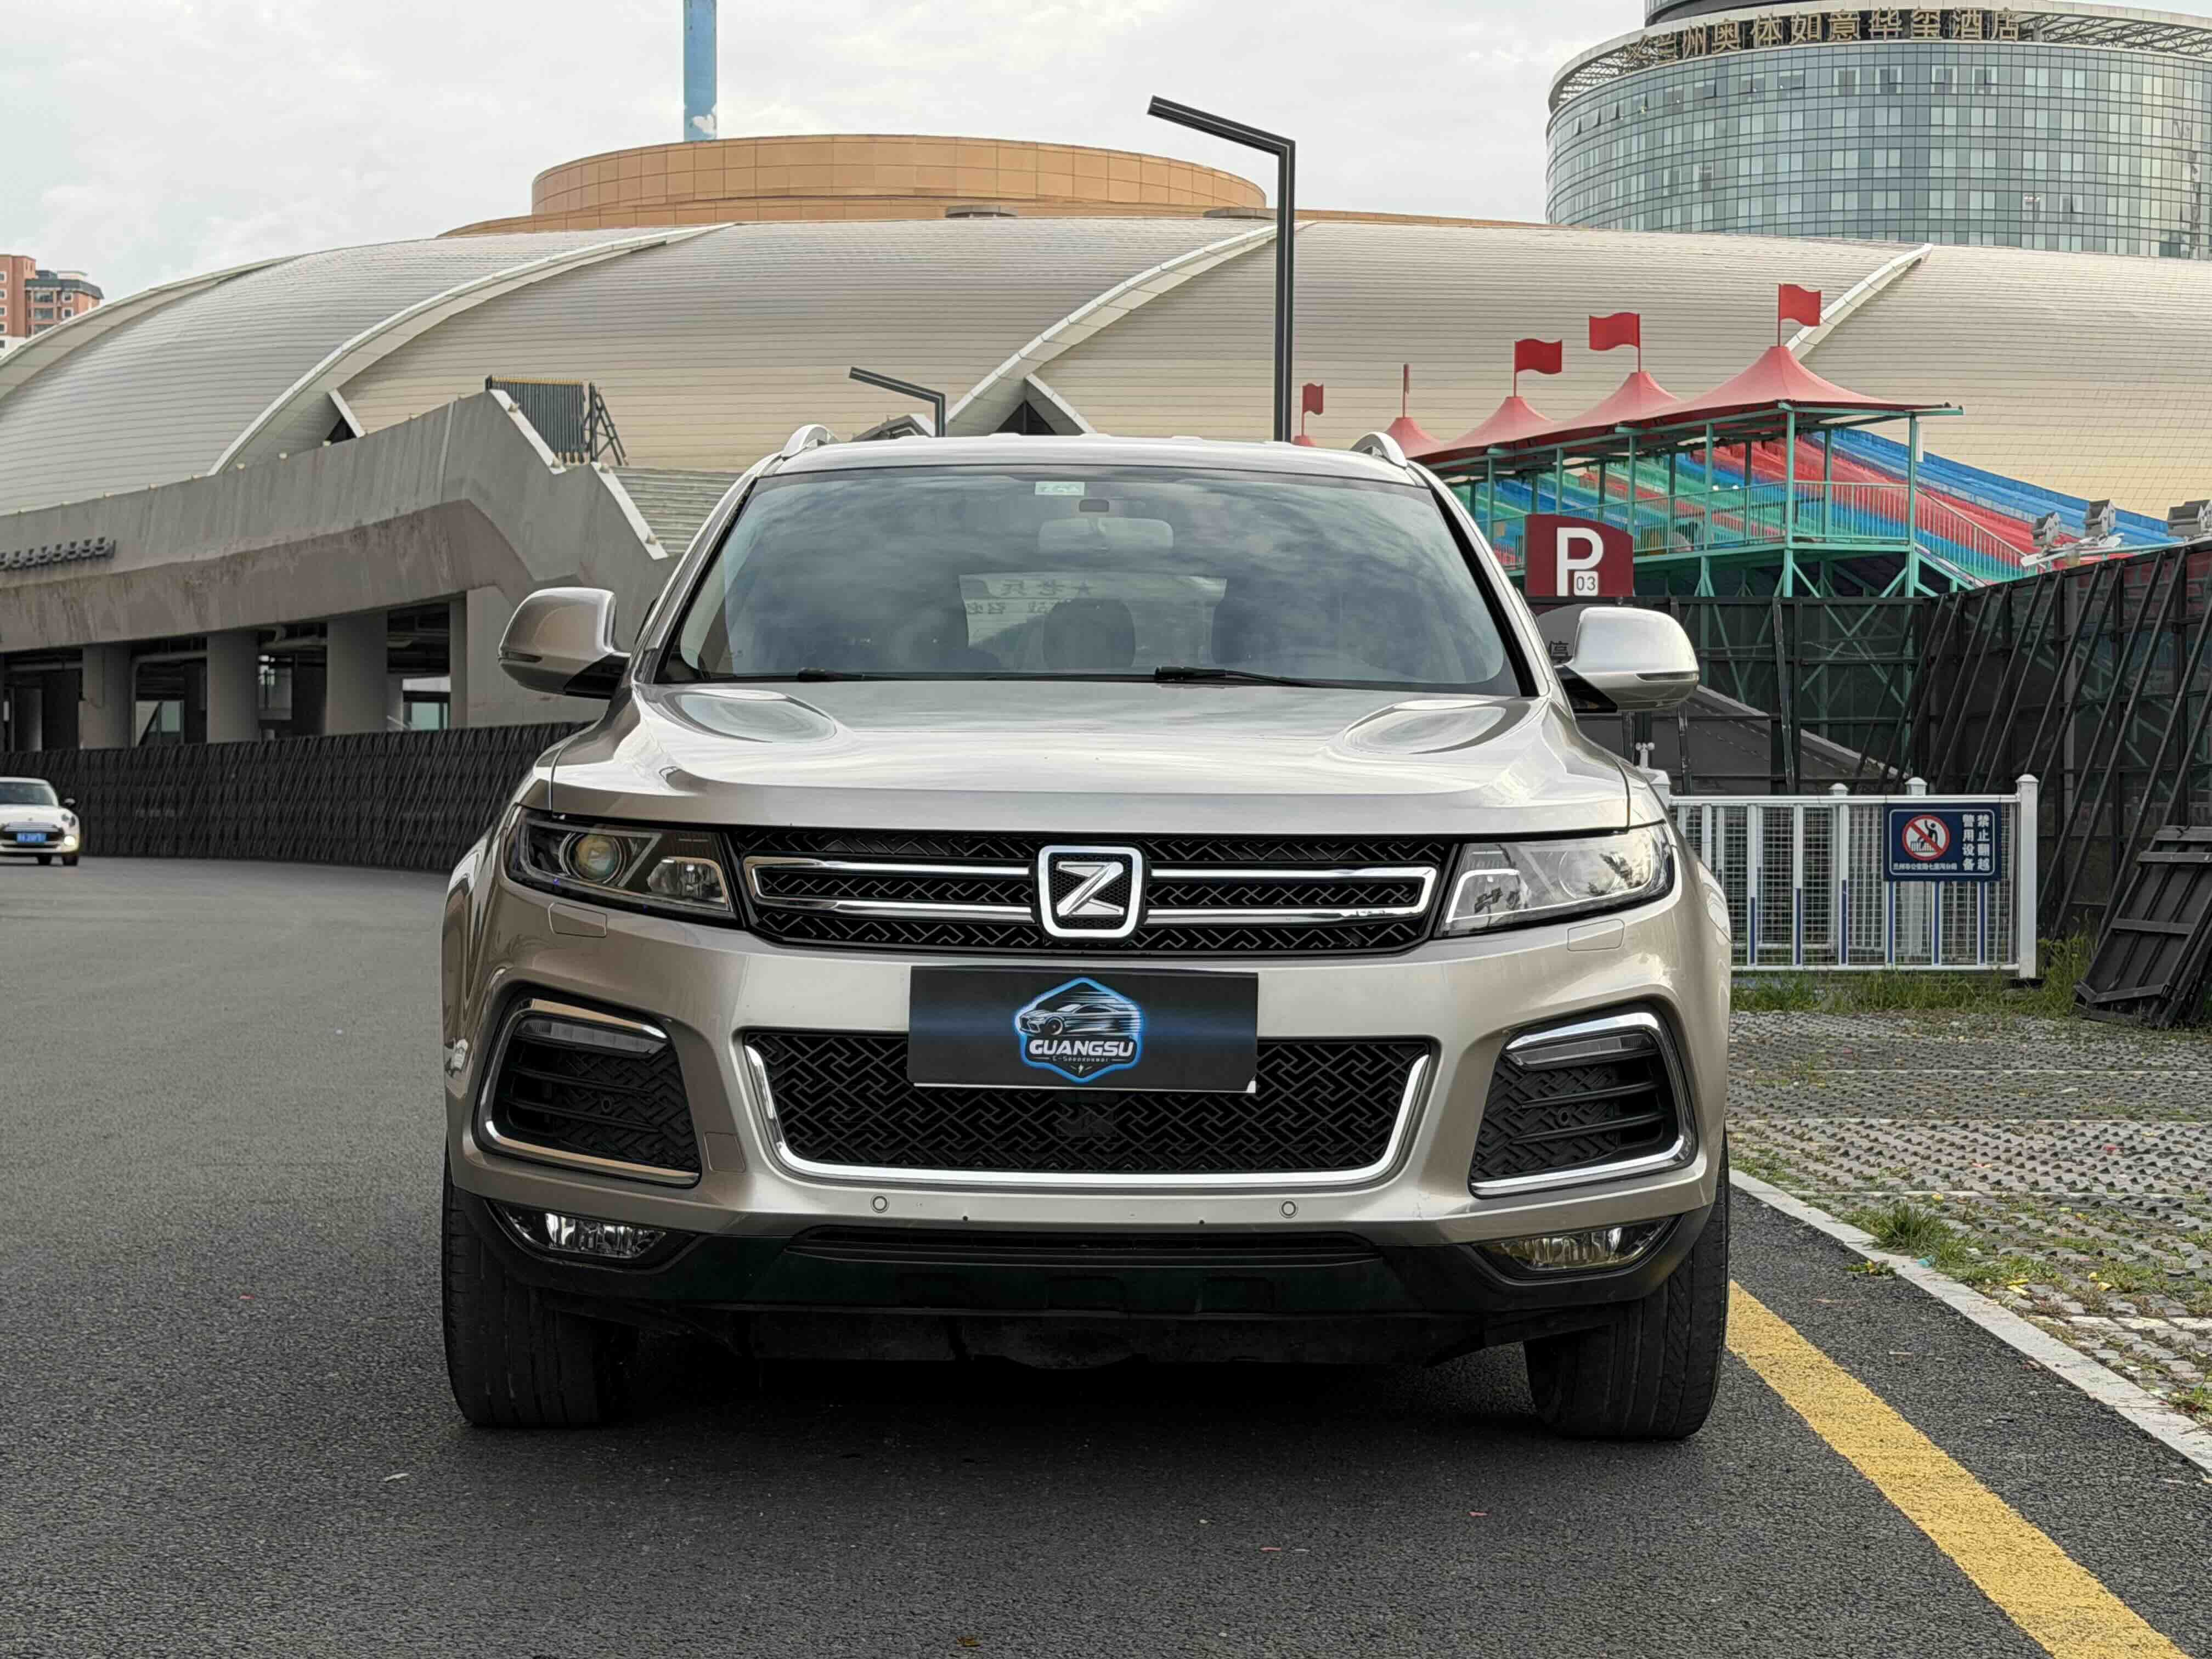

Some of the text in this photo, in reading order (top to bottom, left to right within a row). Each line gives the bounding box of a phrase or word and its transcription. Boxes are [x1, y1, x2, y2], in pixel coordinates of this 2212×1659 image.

[1657, 7, 2019, 65] 兰州奥体如意华玺酒店
[1556, 527, 1604, 596] P
[1576, 576, 1596, 591] 03
[1962, 814, 1975, 871] 警用设备
[1977, 814, 1990, 871] 禁止翻越
[1029, 1040, 1134, 1057] GUANGSU
